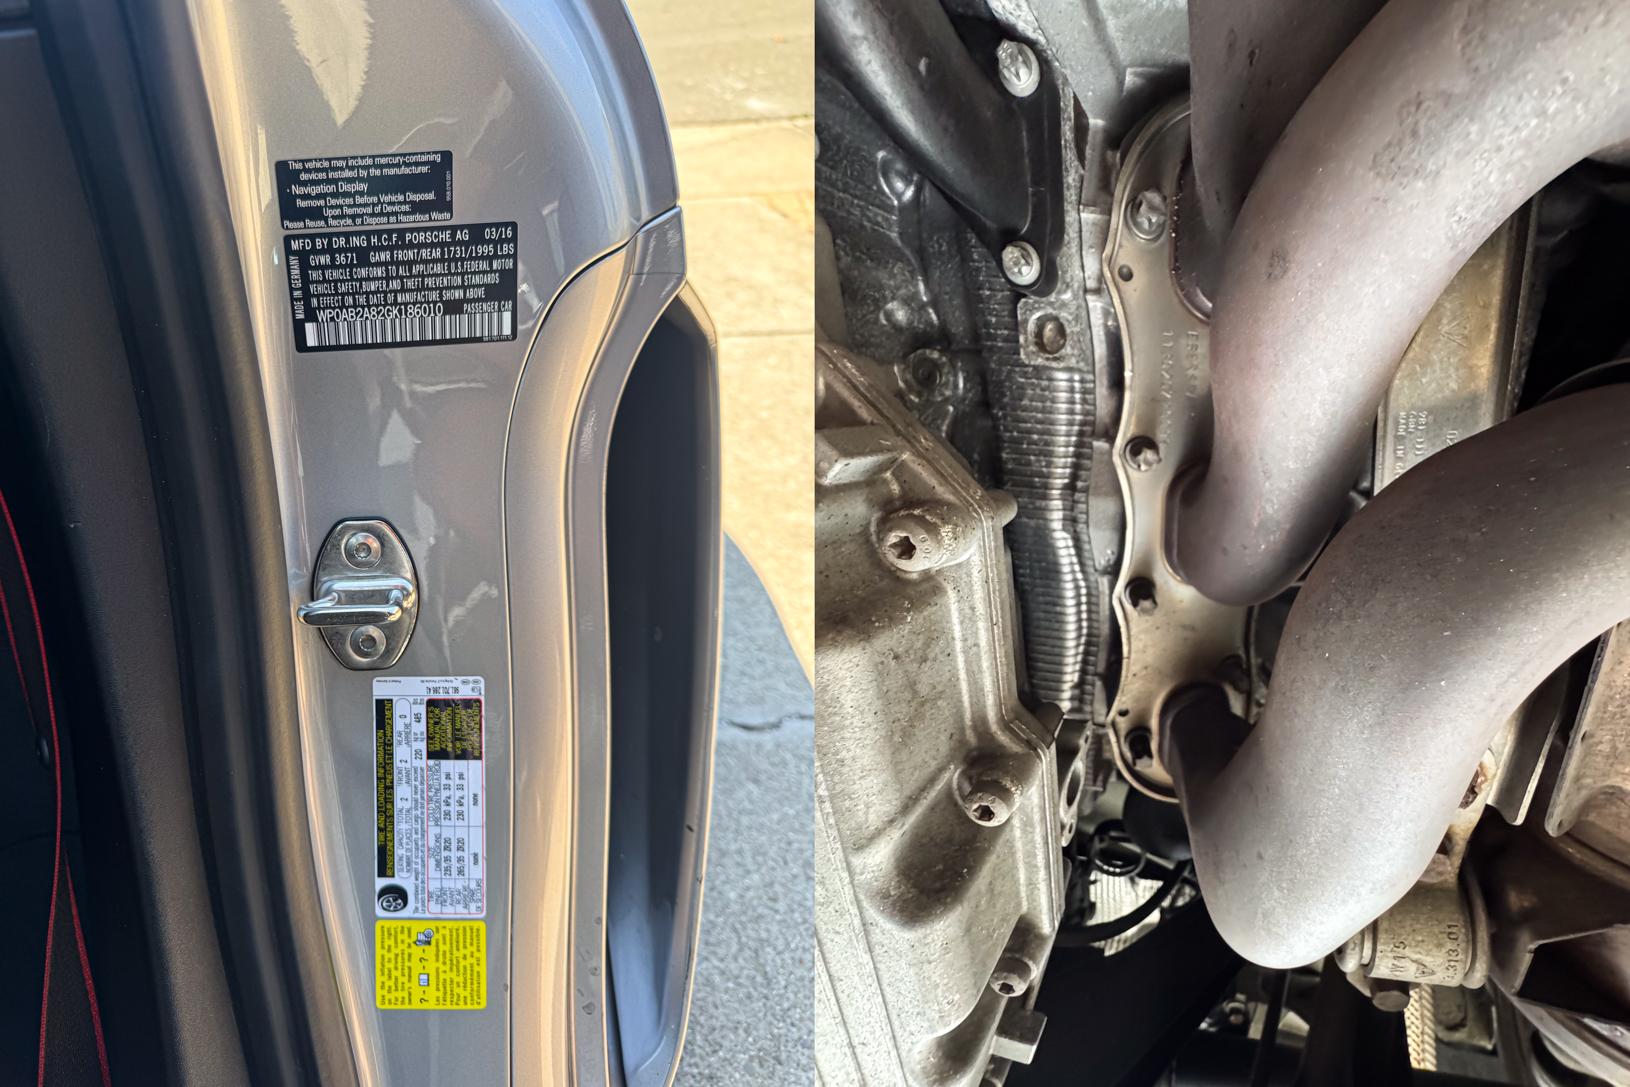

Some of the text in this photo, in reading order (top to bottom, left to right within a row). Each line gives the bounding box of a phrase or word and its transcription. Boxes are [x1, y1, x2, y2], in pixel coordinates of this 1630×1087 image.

[288, 153, 441, 170] This vehicle may include mercury-containing
[300, 172, 326, 180] devices
[329, 169, 357, 178] installed
[359, 169, 368, 178] by
[383, 166, 430, 176] manufacturer:
[292, 181, 368, 196] Navigation Display
[297, 191, 436, 208] Remove Devices Before Vehicle Disposal.
[323, 204, 412, 217] Upon Removal of Devices:
[284, 220, 304, 229] Please
[306, 219, 327, 228] Reuse,
[328, 218, 354, 228] Recycle,
[363, 215, 388, 225] Dispose
[398, 213, 429, 222] Hazardous
[431, 211, 450, 220] Waste
[291, 227, 512, 250] MFD BY DR.ING H.C.F. PORSCHE AG 03/16
[310, 243, 514, 266] GVWR 3671 GAWR FRONT/REAR 1731/1995 LBS
[289, 255, 302, 288] GERMANY
[308, 259, 513, 281] THIS VEHICLE CONFORMS TO ALL APPLICABLE U.S.FEDERAL MOTOR
[310, 283, 334, 294] VEHICLE
[404, 279, 422, 289] THEFT
[425, 276, 462, 288] PREVENTION
[464, 273, 499, 285] STANDARDS
[311, 288, 485, 308] IN EFFECT ON THE DATE OF MANUFACTURE SHOWN ABOVE
[464, 302, 498, 313] PASSENGER
[501, 300, 512, 311] CAR
[294, 300, 305, 319] MADE
[443, 772, 451, 780] psi
[456, 772, 465, 780] psi
[456, 810, 464, 821] 230
[444, 856, 452, 876] 235/35
[456, 856, 465, 876] 265/35
